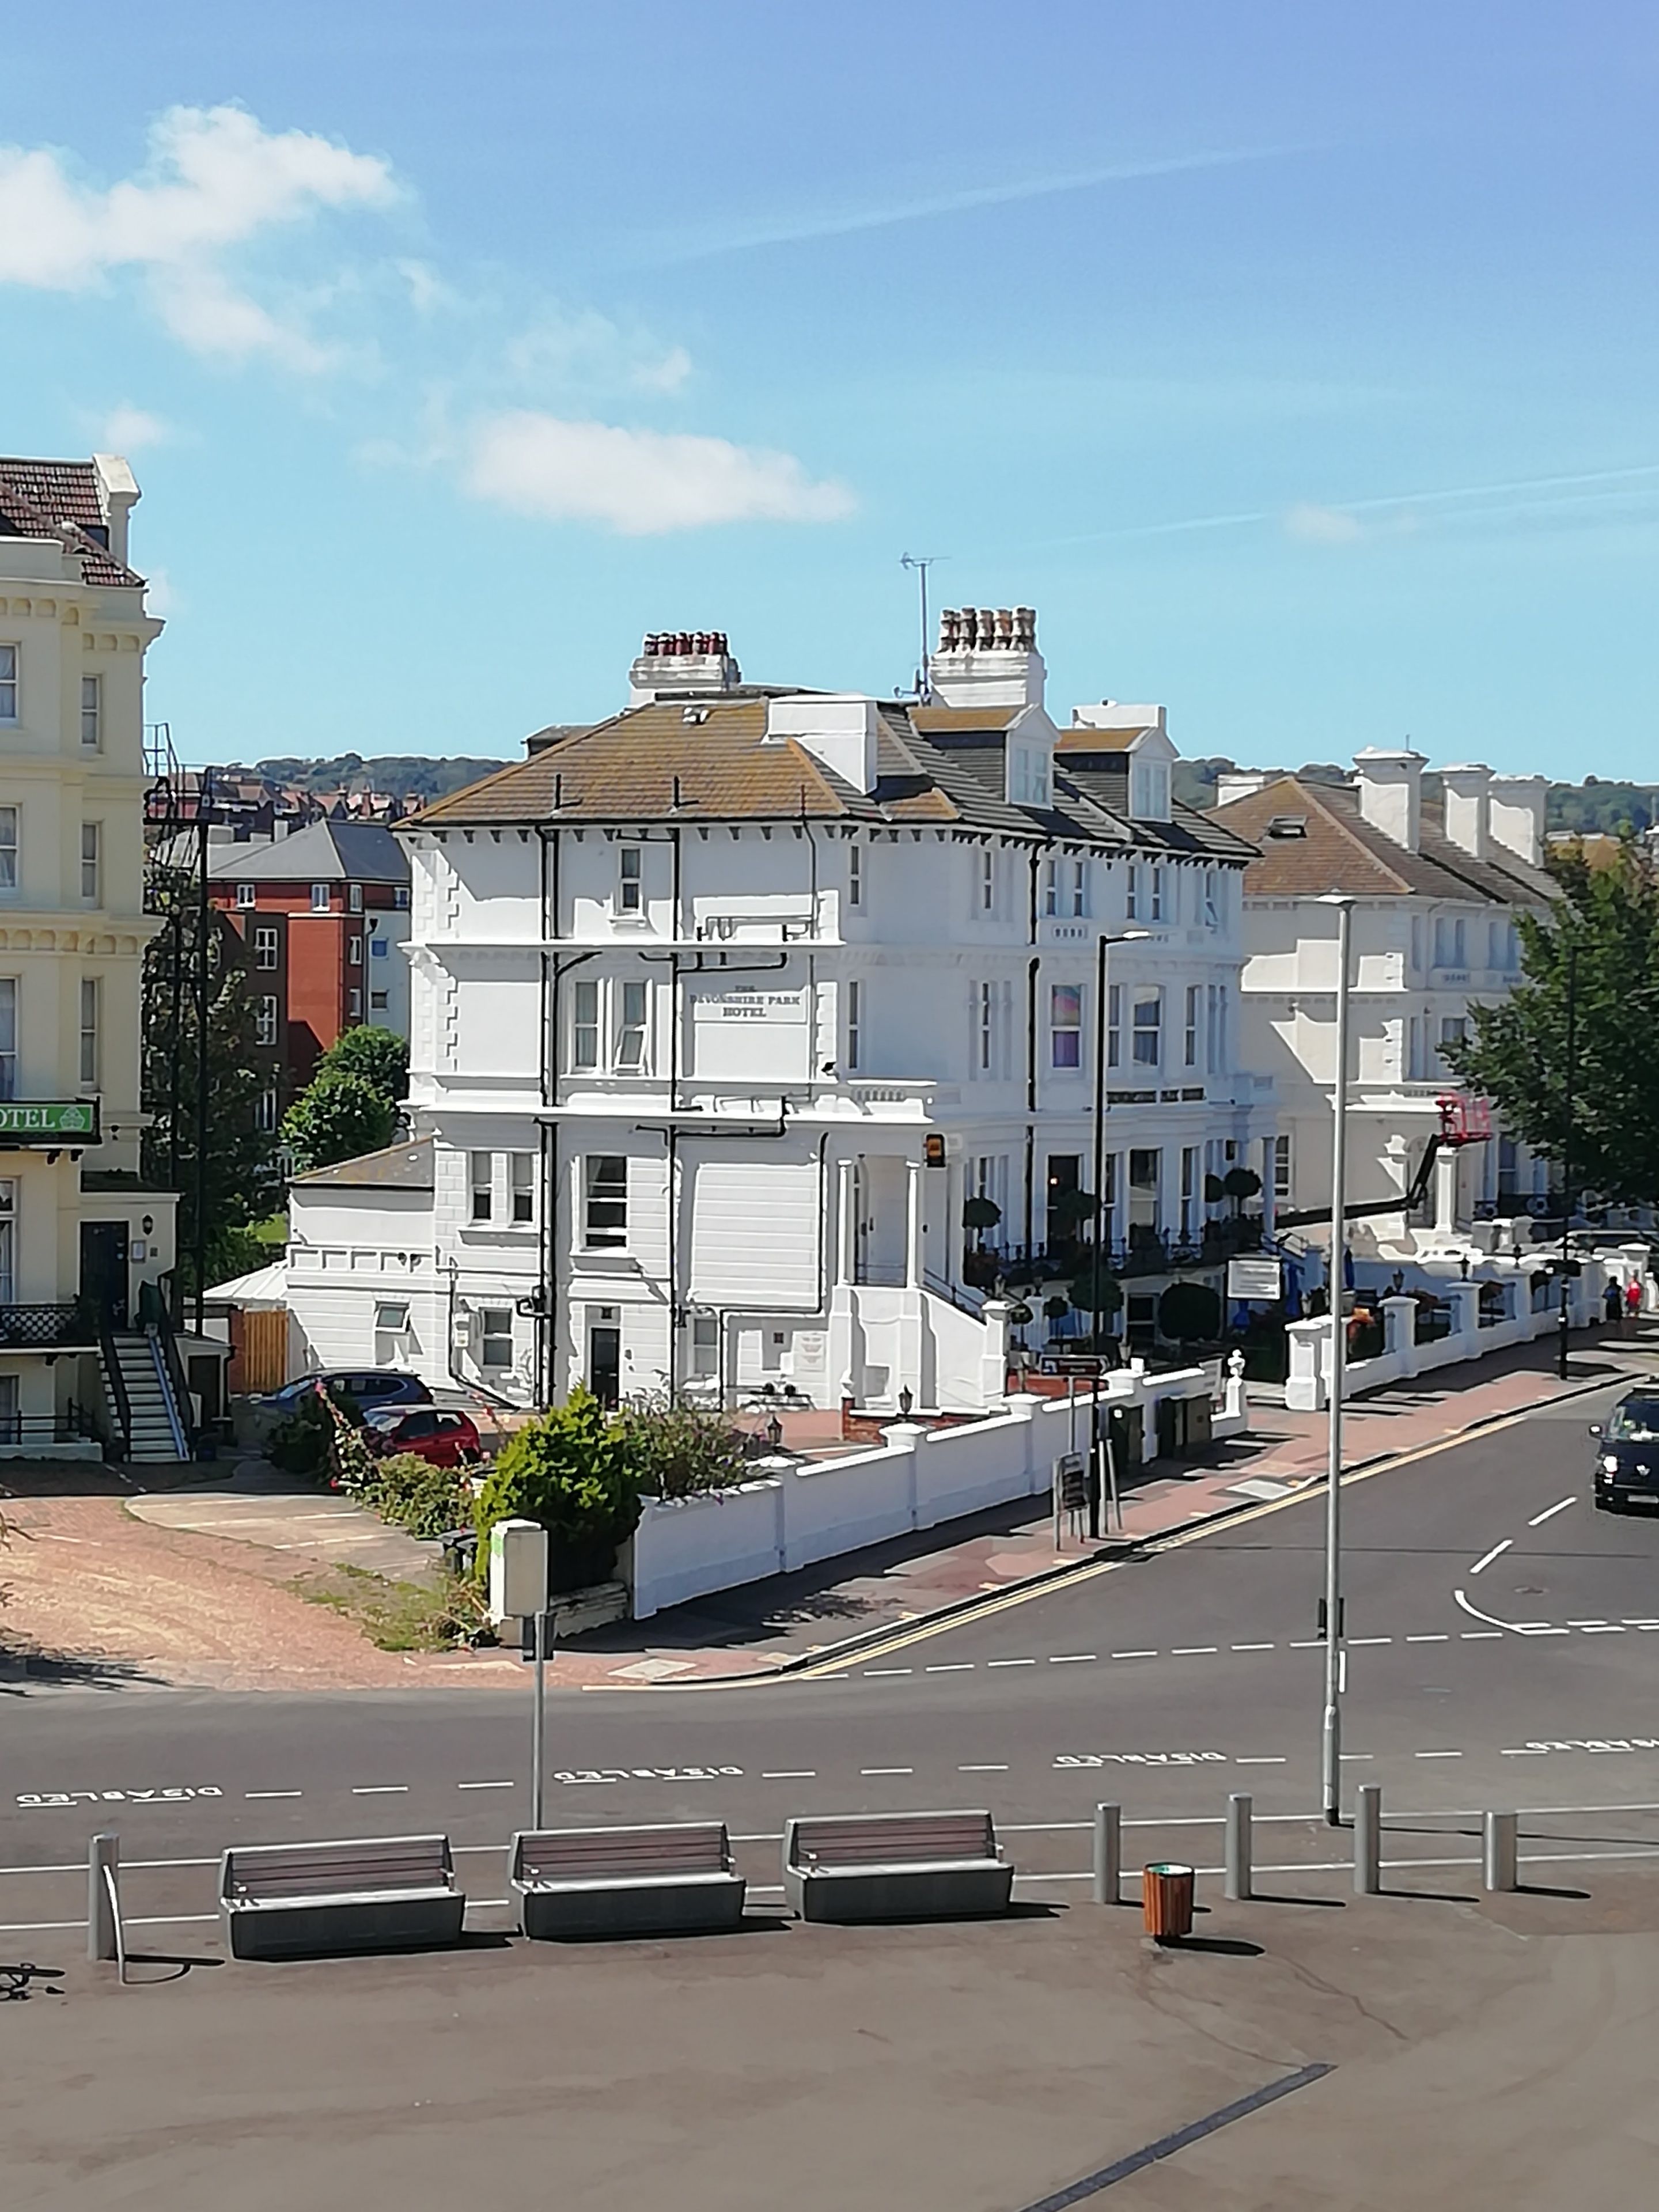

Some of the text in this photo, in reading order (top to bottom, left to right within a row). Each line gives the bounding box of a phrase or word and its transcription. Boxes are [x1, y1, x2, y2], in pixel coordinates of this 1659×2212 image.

[768, 995, 800, 1005] PARK
[723, 1007, 766, 1017] HOTEL
[16, 1787, 223, 1804] DISABLED
